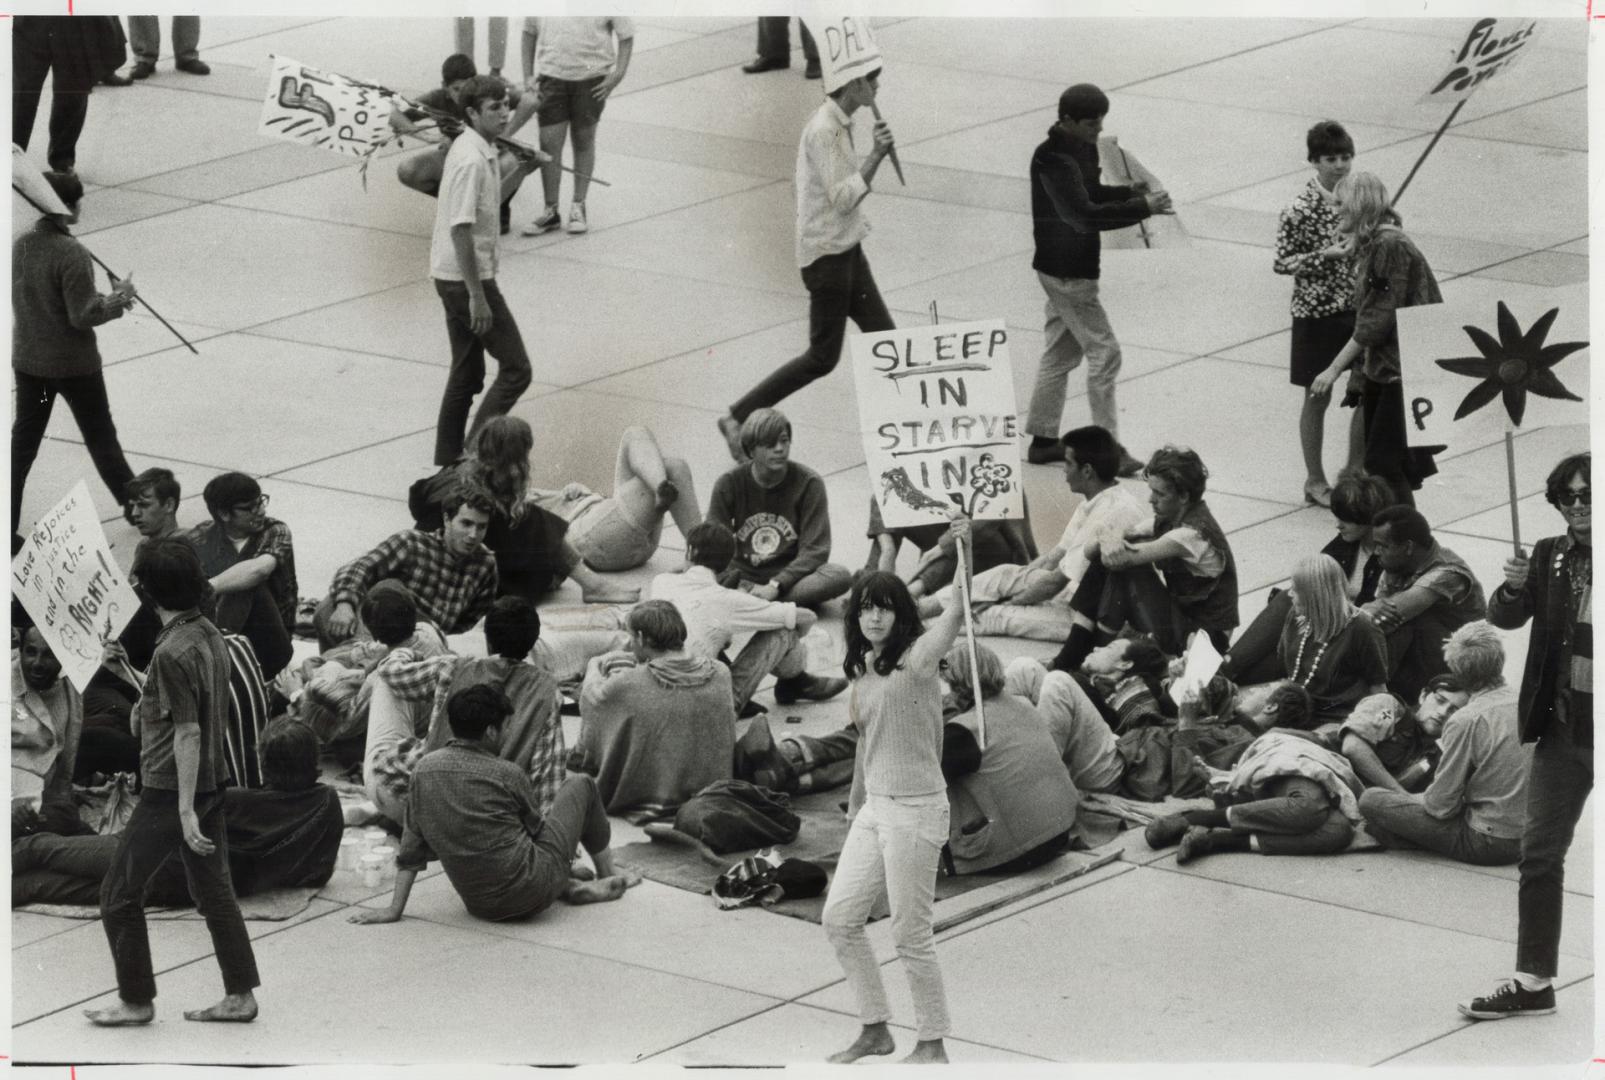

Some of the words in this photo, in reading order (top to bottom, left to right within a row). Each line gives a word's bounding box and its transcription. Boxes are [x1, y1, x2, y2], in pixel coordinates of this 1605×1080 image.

[872, 329, 1008, 372] SLEEP
[920, 377, 968, 408] IN
[878, 415, 1017, 450] STARVE
[920, 456, 968, 490] IN
[13, 551, 36, 588] Love
[44, 591, 57, 627] and
[68, 549, 119, 636] RIGHT!
